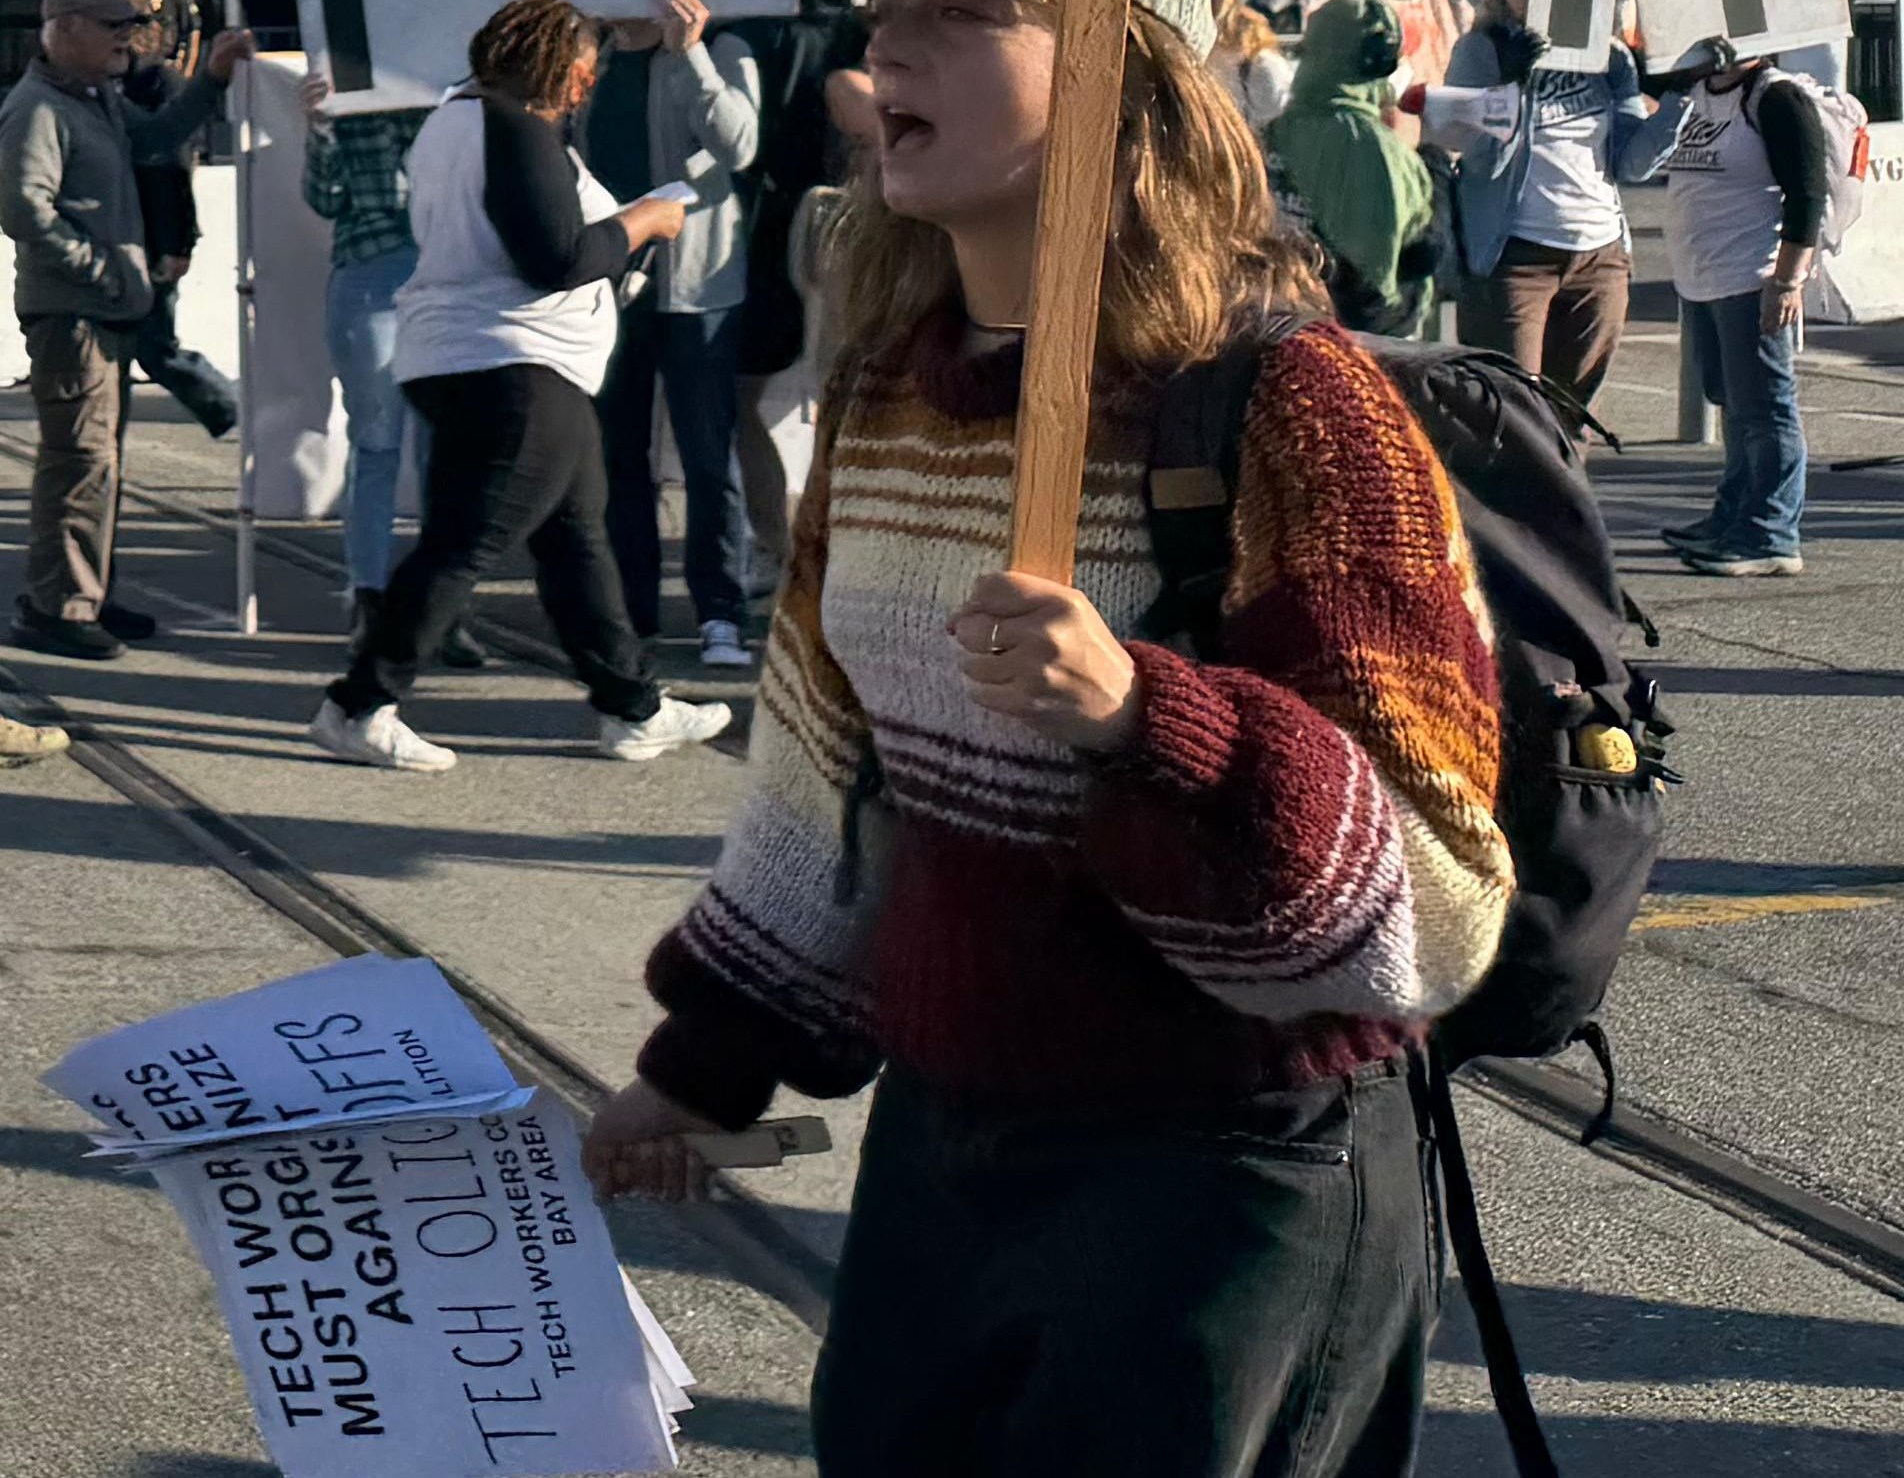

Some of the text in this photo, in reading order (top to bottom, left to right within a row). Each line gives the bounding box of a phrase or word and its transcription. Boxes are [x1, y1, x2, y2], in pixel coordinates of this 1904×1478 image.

[493, 1149, 553, 1293] WORKERS
[540, 1191, 577, 1245] BAY
[248, 1282, 323, 1428] TECH
[301, 1279, 385, 1436] MUST
[436, 1305, 556, 1464] TECH
[536, 1300, 576, 1378] TECH
